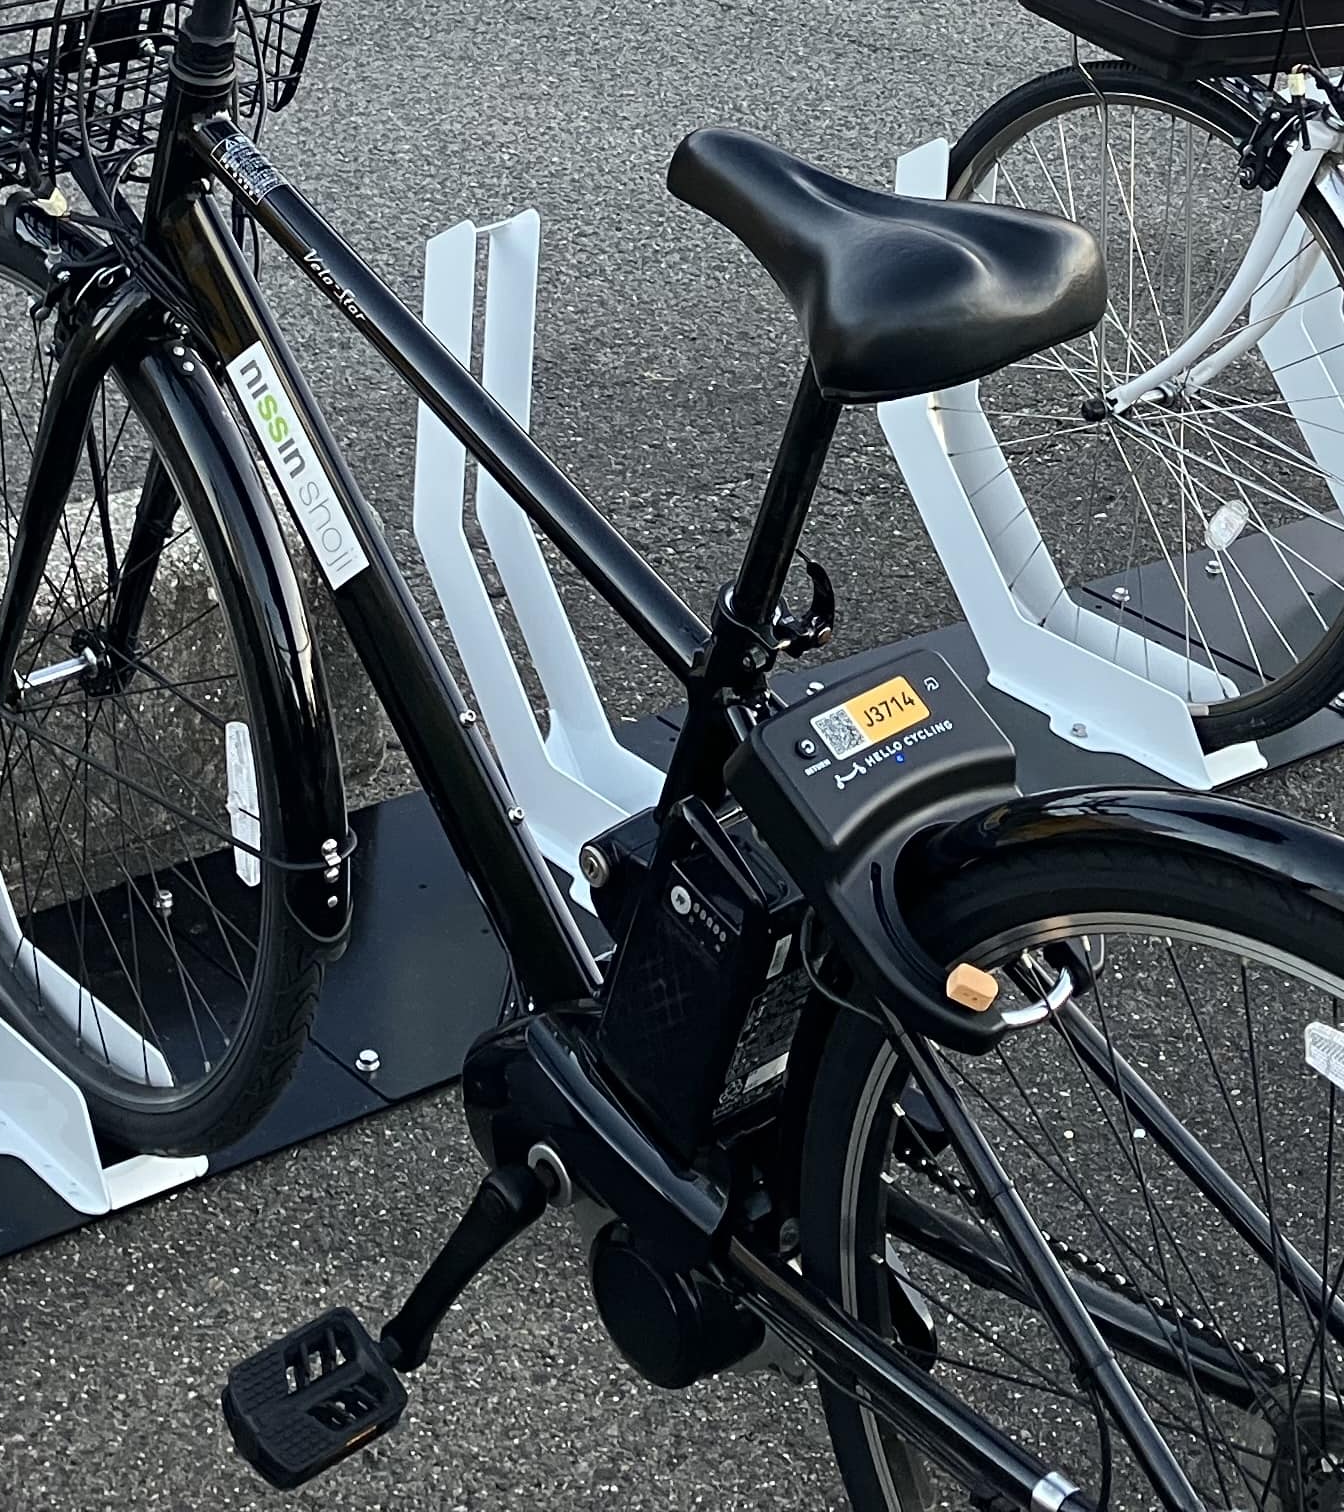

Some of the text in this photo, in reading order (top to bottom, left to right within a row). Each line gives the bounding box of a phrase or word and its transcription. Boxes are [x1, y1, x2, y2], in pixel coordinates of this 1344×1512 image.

[239, 358, 358, 573] nissin shoji
[862, 691, 916, 728] J3714
[864, 719, 954, 768] HELLO CYCLING
